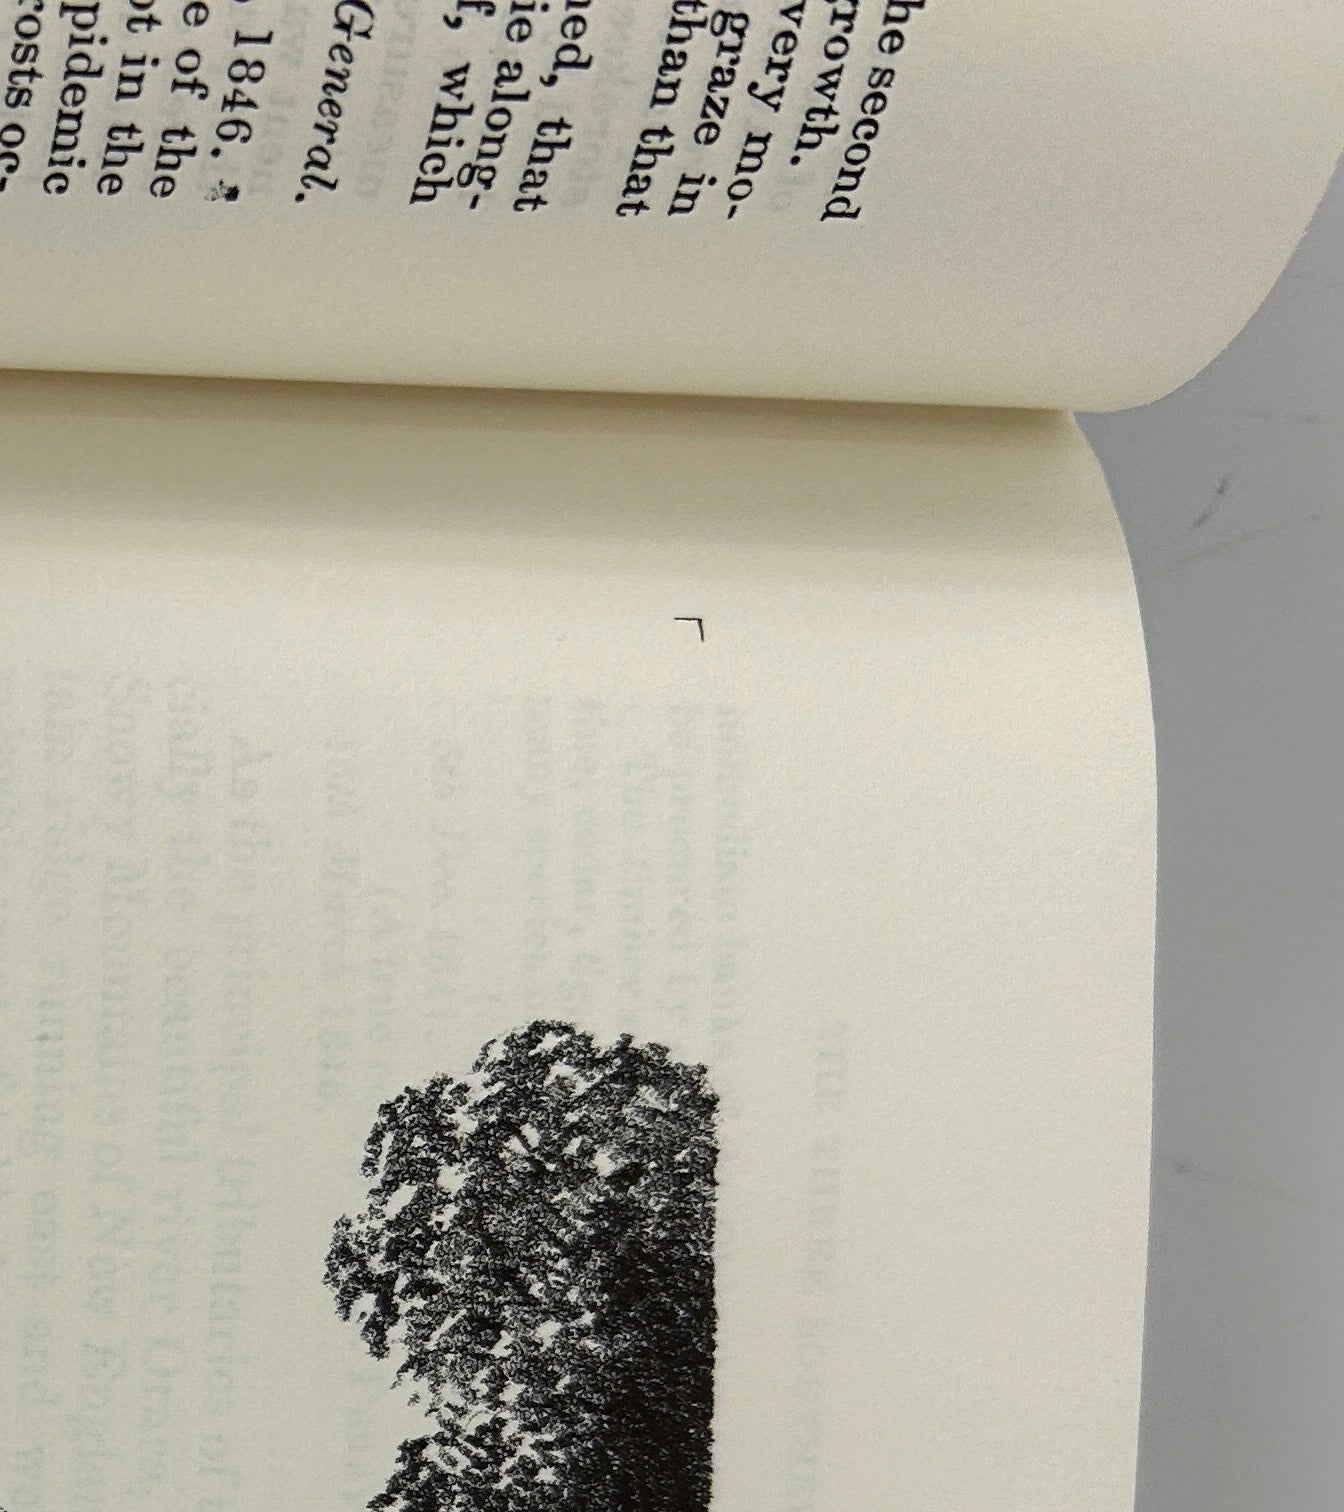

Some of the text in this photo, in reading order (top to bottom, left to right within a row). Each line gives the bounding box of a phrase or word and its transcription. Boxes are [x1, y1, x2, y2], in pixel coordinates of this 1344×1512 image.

[43, 1, 108, 194] pidemic
[115, 54, 160, 102] in
[171, 47, 209, 100] of
[210, 30, 274, 158] 1846.
[295, 0, 375, 203] General.
[409, 59, 474, 209] which
[456, 59, 532, 209] along-
[615, 0, 709, 217] than that
[667, 9, 750, 216] graze in
[790, 0, 860, 166] rowth.
[820, 67, 898, 222] second
[97, 122, 145, 195] the
[150, 125, 197, 198] the
[513, 116, 573, 212] that
[727, 131, 774, 219] mo-
